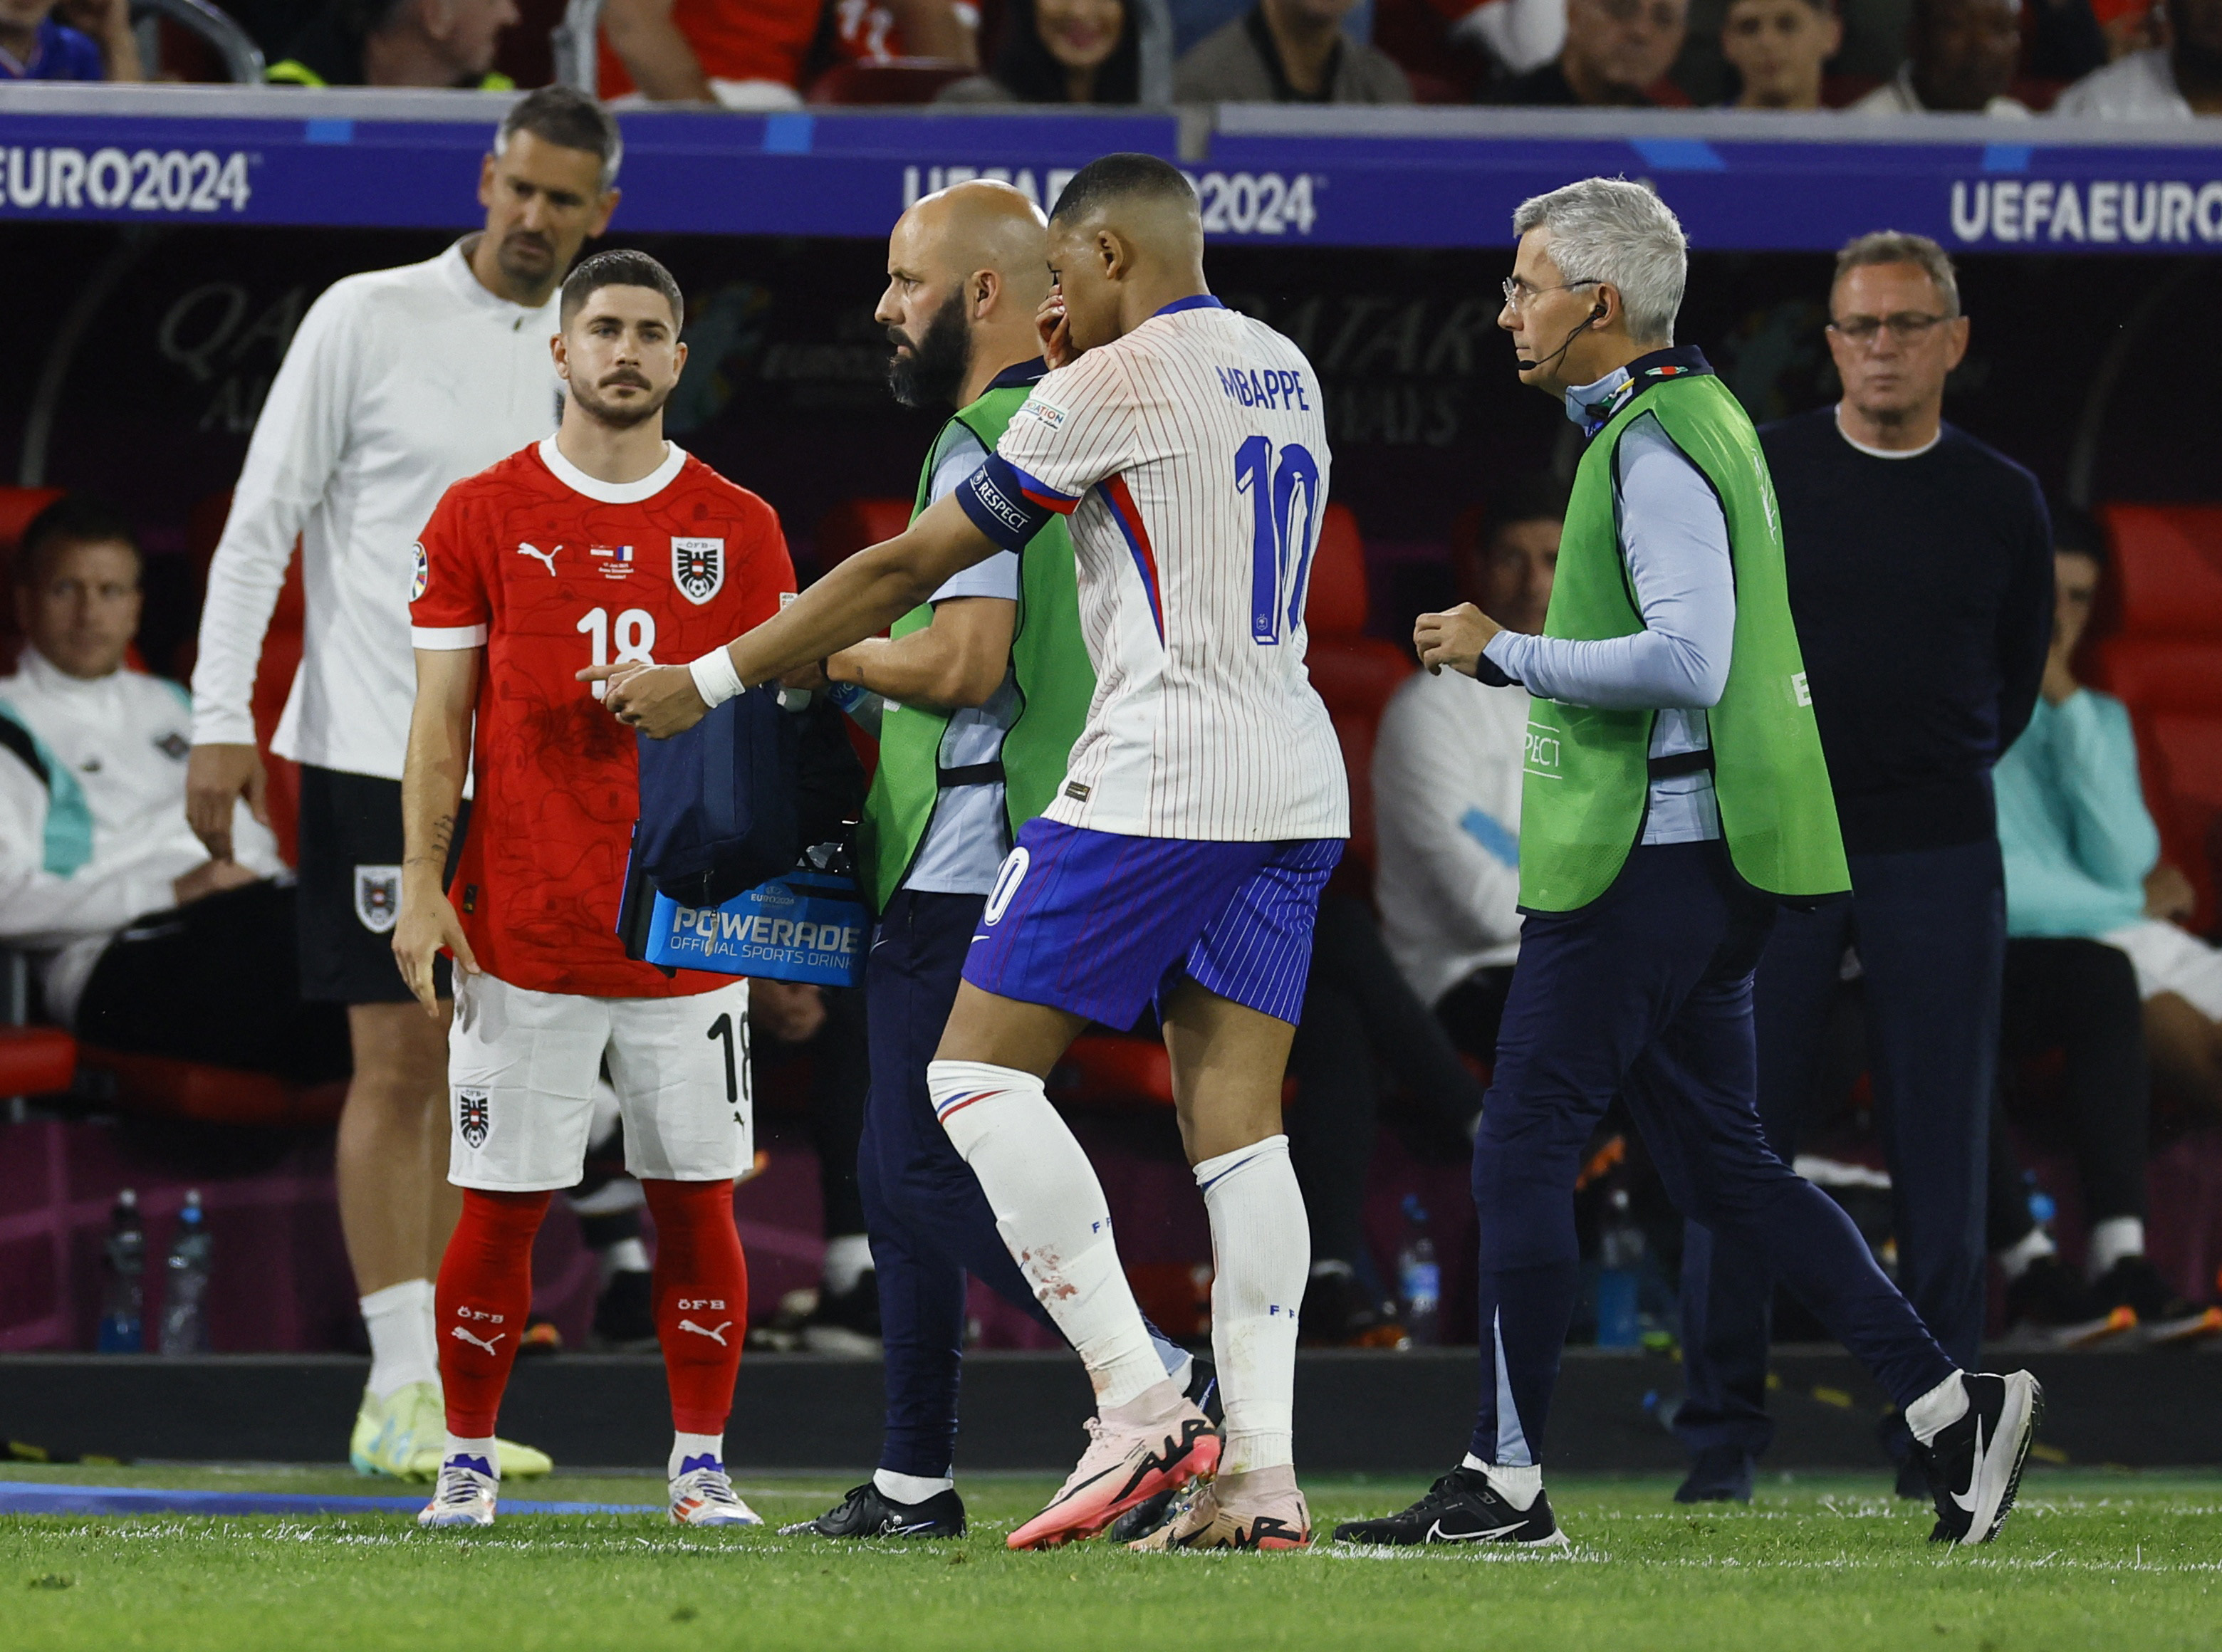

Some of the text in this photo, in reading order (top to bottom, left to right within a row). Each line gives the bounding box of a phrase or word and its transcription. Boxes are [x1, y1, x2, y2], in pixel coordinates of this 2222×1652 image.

[0, 147, 251, 211] URO2024
[1215, 366, 1310, 411] MBAPPE
[978, 481, 1028, 528] RESPECT
[1235, 435, 1320, 645] 10
[576, 607, 655, 699] 18
[670, 936, 738, 956] OFFIIAL
[741, 944, 804, 964] SPORTS
[673, 906, 861, 953] POWERADE
[457, 1306, 504, 1324] ÖFB
[678, 1299, 726, 1310] ÖFB
